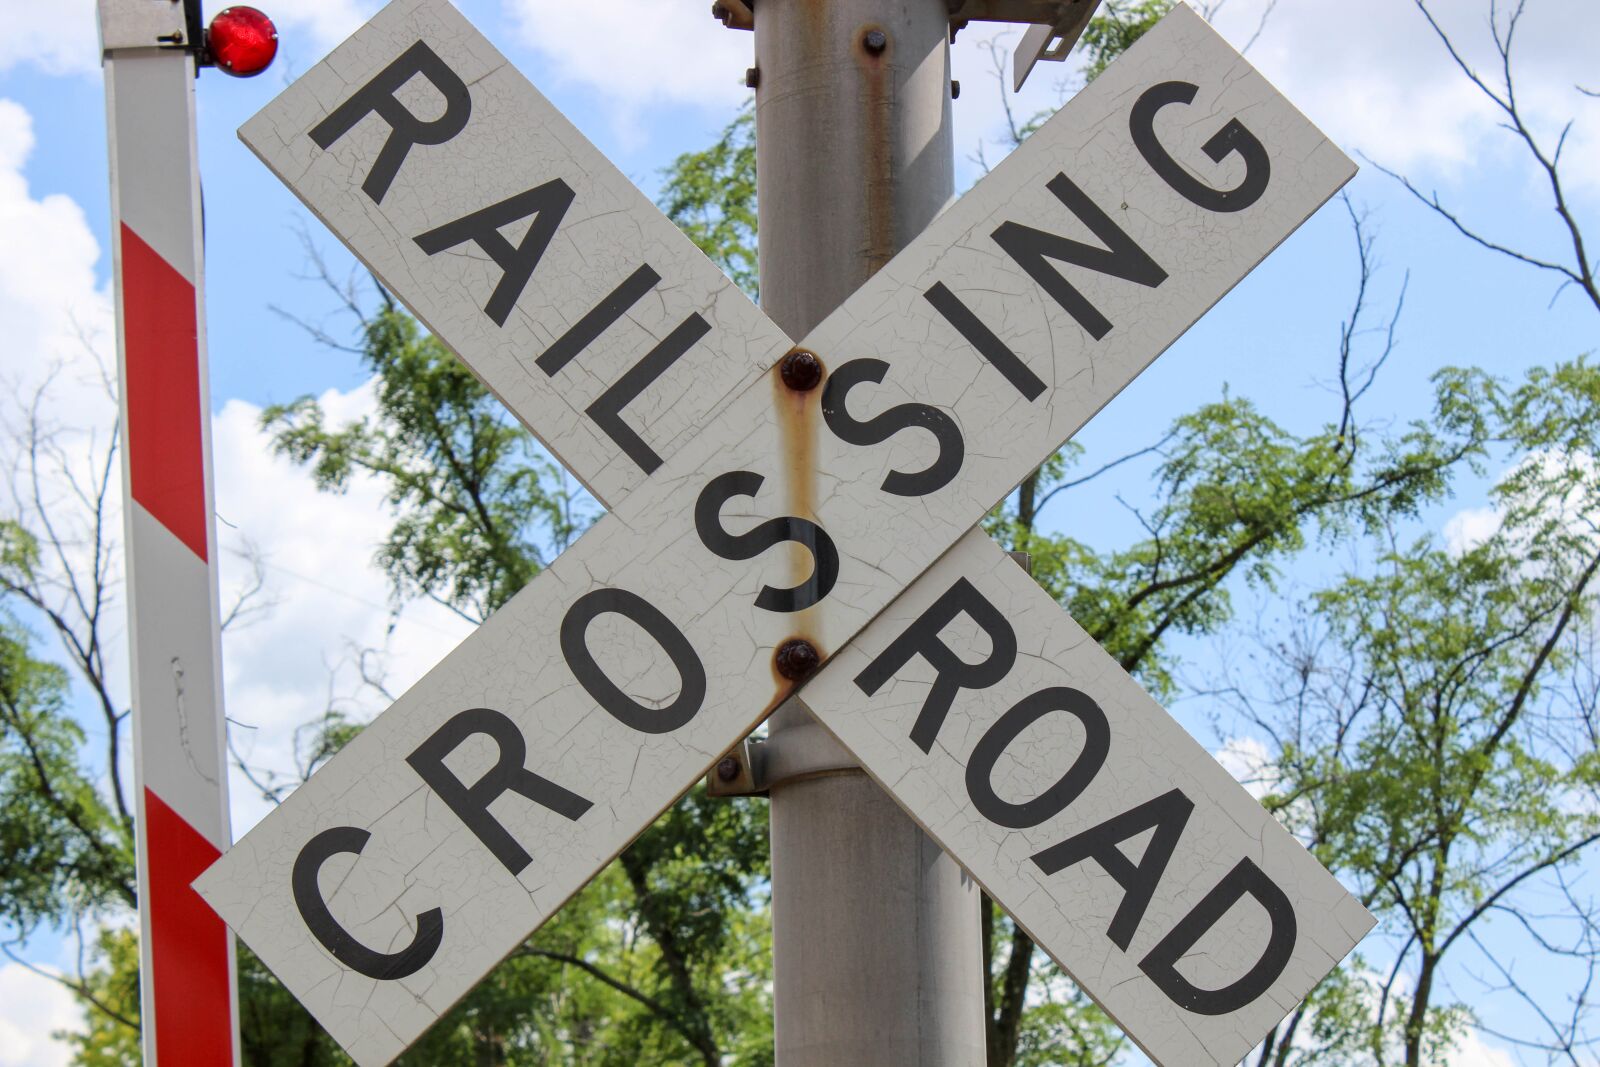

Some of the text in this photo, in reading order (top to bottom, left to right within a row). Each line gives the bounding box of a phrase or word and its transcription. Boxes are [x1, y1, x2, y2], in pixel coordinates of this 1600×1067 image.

[292, 81, 1270, 980] CROSSING
[308, 39, 1297, 1016] RAIL ROAD
